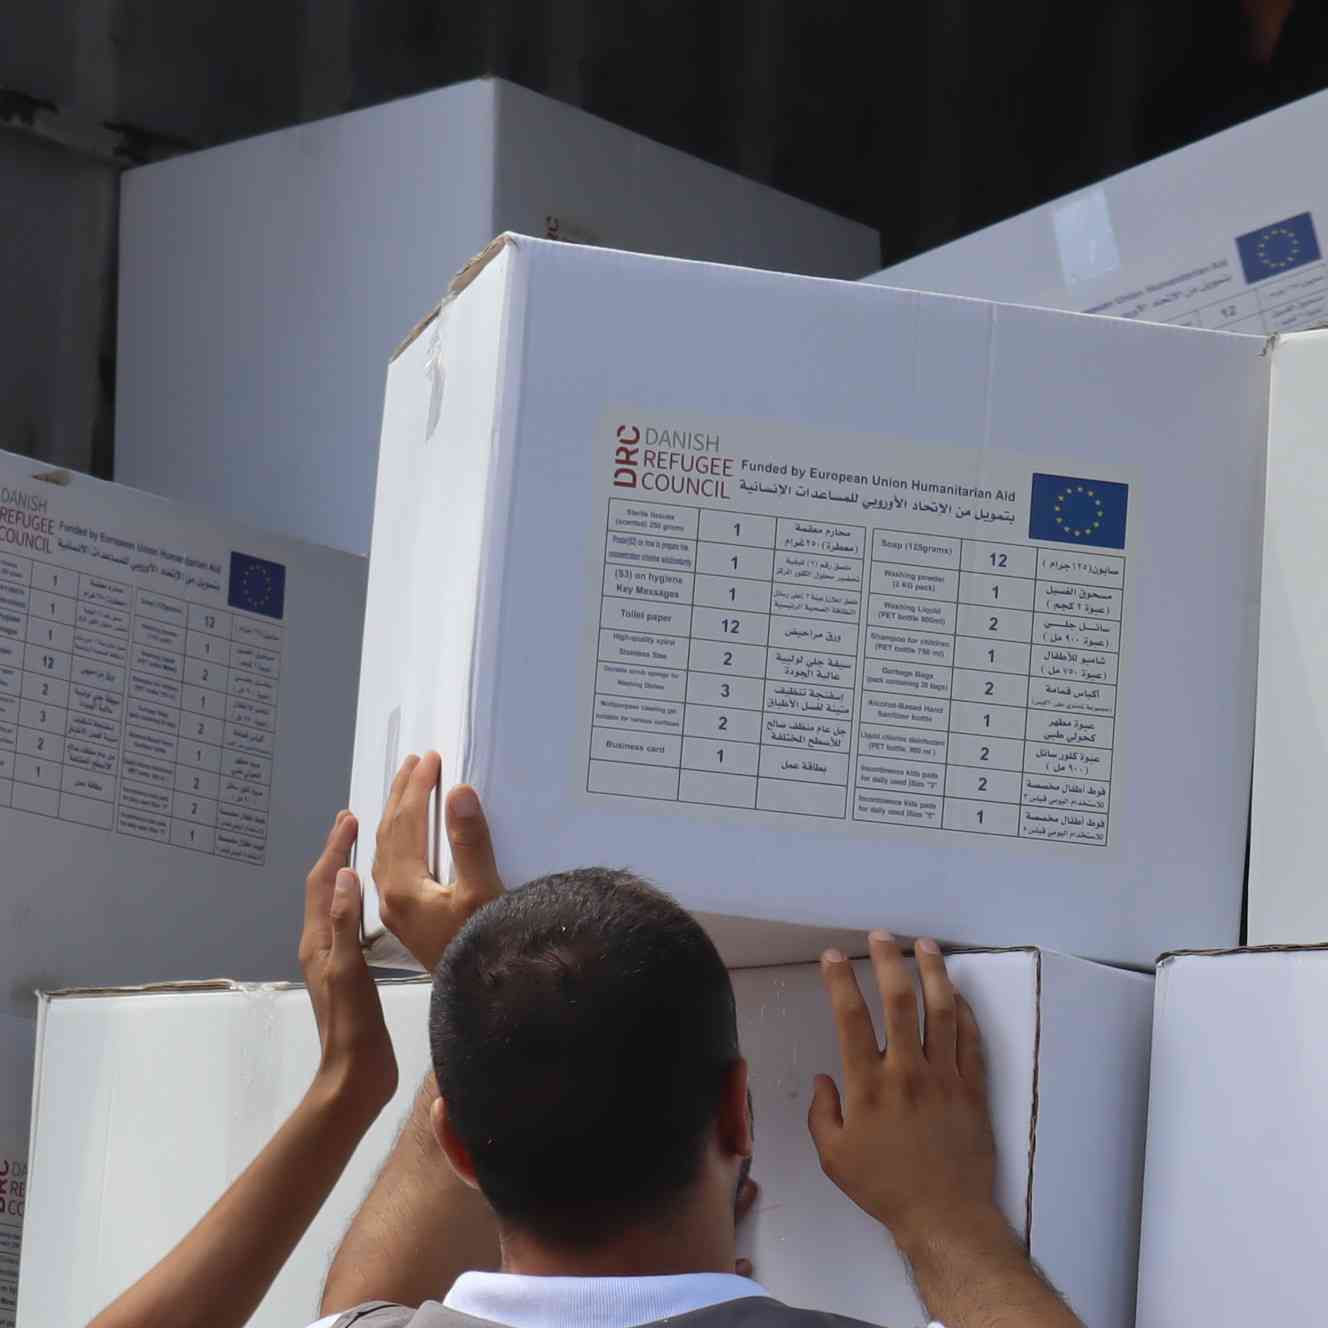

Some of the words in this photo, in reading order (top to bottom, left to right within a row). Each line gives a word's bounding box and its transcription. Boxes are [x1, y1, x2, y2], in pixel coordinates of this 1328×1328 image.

[645, 427, 720, 453] DANISH
[613, 423, 641, 488] DRC
[643, 449, 734, 477] REFUGEE
[641, 471, 731, 499] COUNCIL
[741, 459, 787, 475] Funded
[791, 465, 805, 479] by
[809, 466, 868, 487] European
[871, 474, 906, 489] Union
[911, 478, 991, 499] Humanitarian
[995, 488, 1015, 502] Aid
[1, 484, 48, 514] DANISH
[955, 505, 971, 519] من
[975, 507, 1015, 525] بتمويل
[0, 505, 55, 536] REFUGEE
[733, 522, 740, 536] 1
[730, 555, 737, 569] 1
[989, 552, 1007, 567] 12
[728, 587, 735, 600] 1
[992, 585, 998, 599] 1
[204, 614, 215, 629] 12
[721, 618, 740, 634] 12
[989, 616, 998, 630] 2
[42, 655, 54, 669] 12
[722, 651, 732, 665] 2
[987, 648, 994, 663] 1
[202, 668, 208, 681] 2
[41, 682, 48, 696] 2
[720, 683, 730, 697] 3
[984, 681, 993, 695] 2
[39, 709, 46, 723] 3
[718, 716, 727, 730] 2
[983, 714, 989, 727] 1
[197, 722, 204, 735] 2
[37, 736, 44, 751] 2
[716, 749, 723, 762] 1
[980, 746, 989, 760] 2
[192, 776, 199, 790] 2
[978, 776, 987, 791] 2
[191, 801, 197, 815] 2
[976, 809, 983, 823] 1
